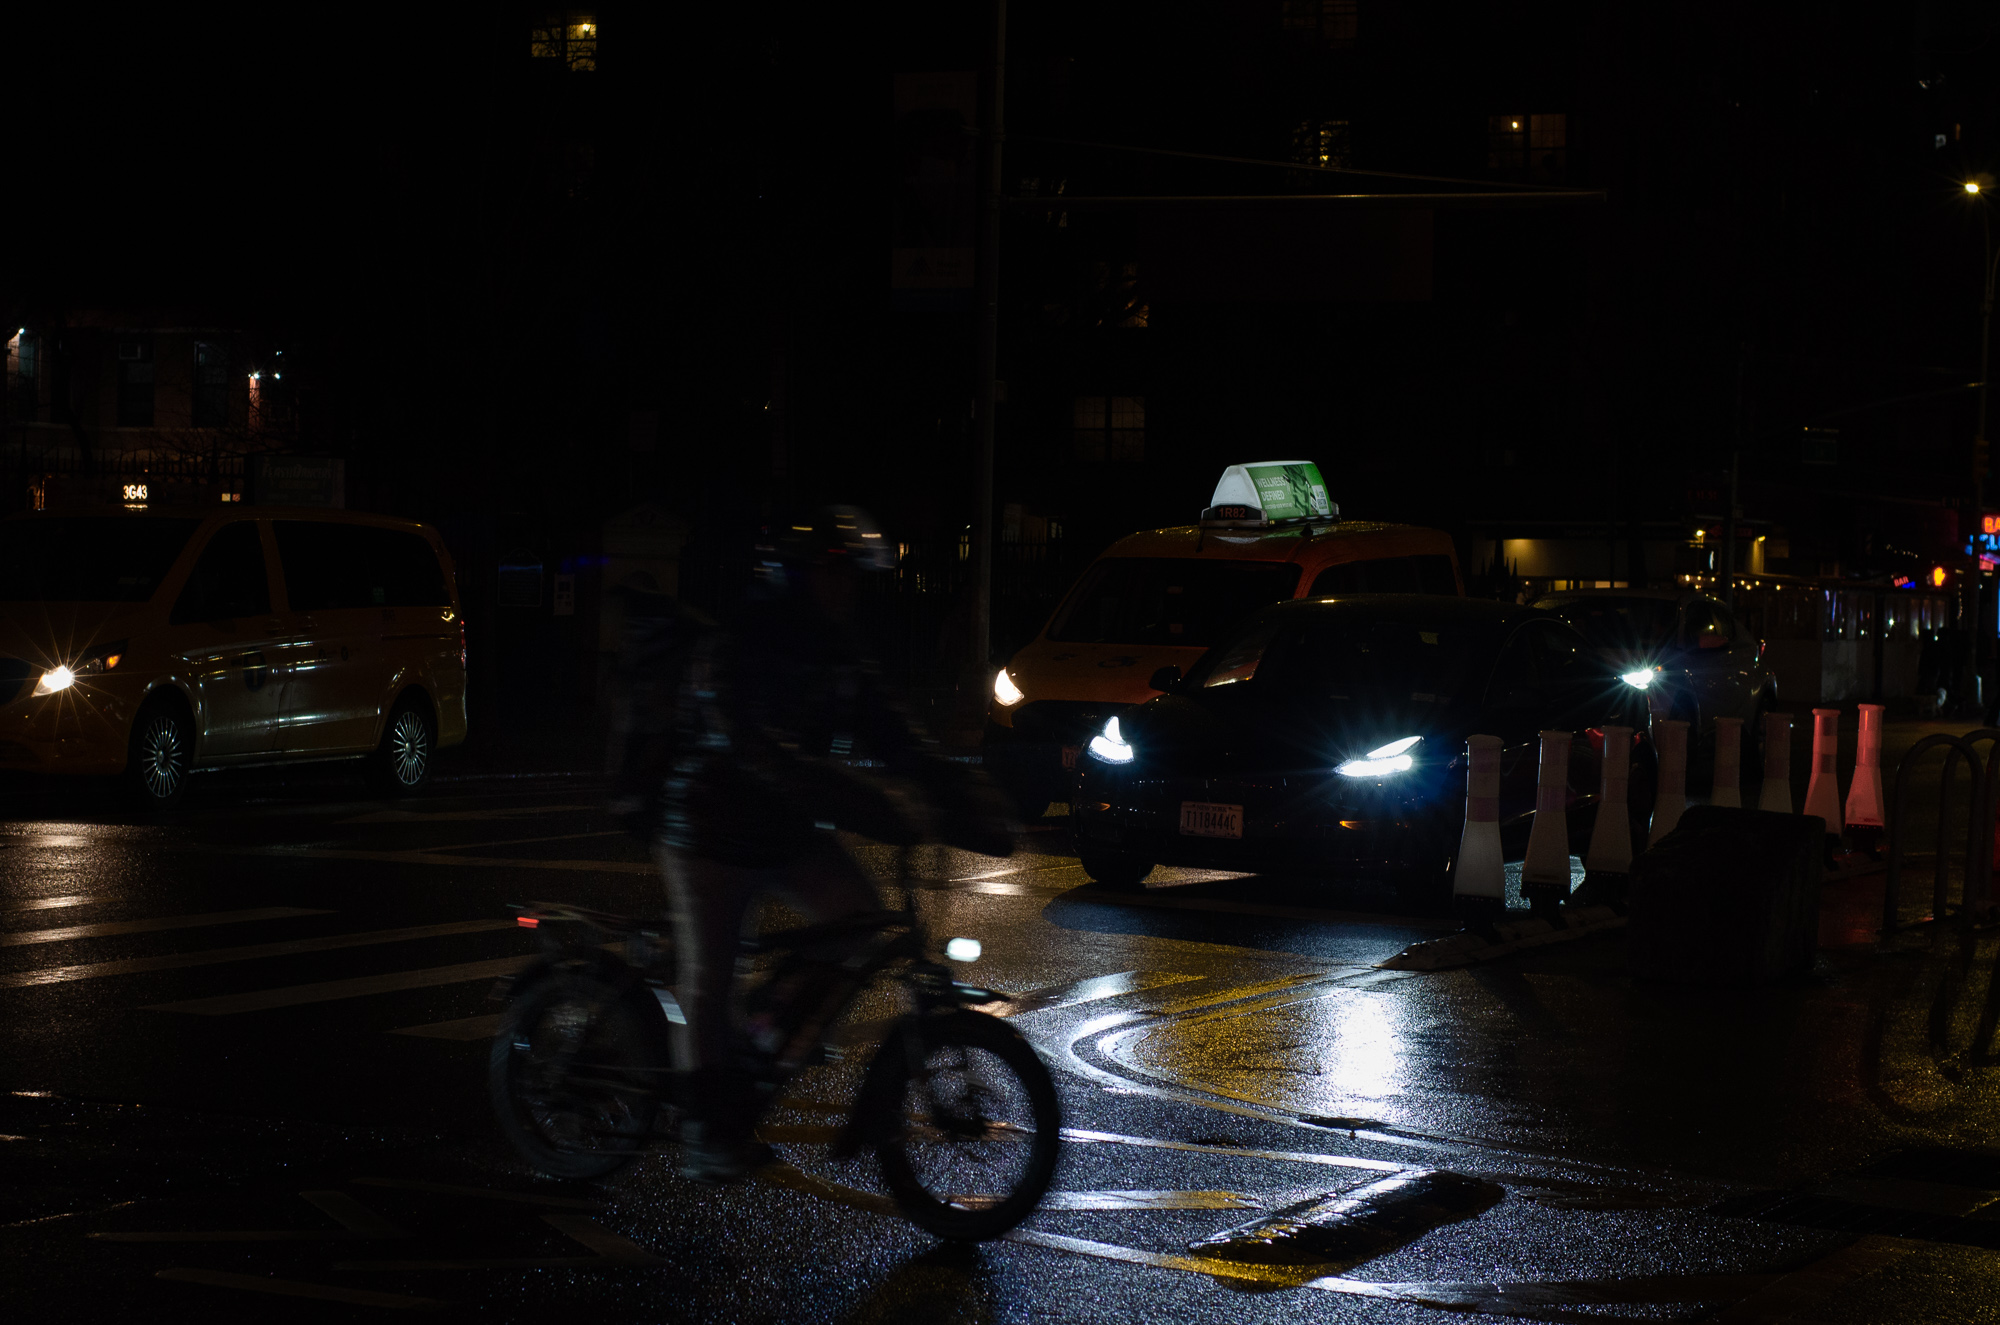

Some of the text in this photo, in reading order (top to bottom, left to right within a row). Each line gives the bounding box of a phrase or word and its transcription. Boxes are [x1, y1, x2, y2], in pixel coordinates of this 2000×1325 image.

[1255, 476, 1286, 488] WELLNESS
[123, 484, 148, 500] 3G43
[1260, 490, 1285, 501] DEFINED
[1219, 507, 1246, 519] 1R82
[1186, 810, 1237, 831] T118444C
